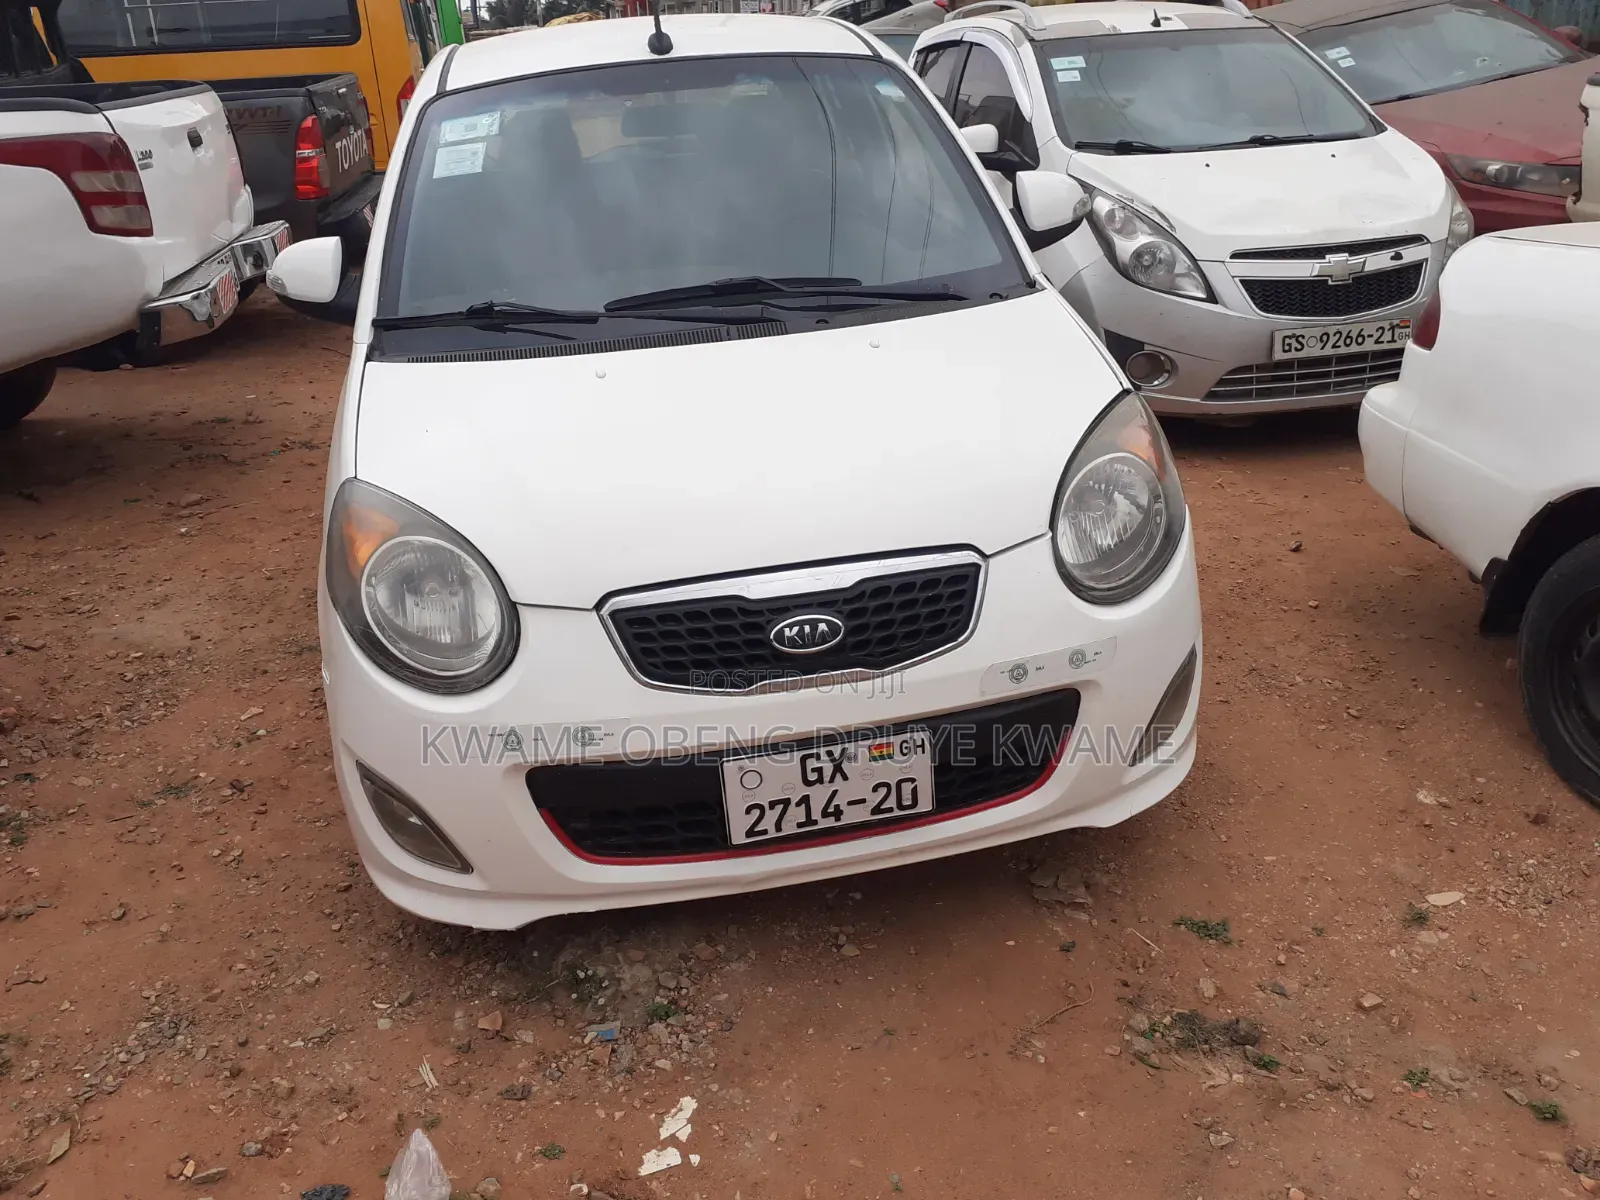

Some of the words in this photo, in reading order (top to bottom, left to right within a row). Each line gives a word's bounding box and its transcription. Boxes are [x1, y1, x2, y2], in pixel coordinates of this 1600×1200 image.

[335, 128, 368, 173] TOYOTA
[1281, 333, 1306, 354] GS
[1319, 325, 1398, 351] 9266-21
[1397, 331, 1411, 341] GH
[783, 622, 832, 647] KIA
[899, 737, 926, 757] GH
[799, 747, 850, 787] GX
[744, 777, 919, 839] 2714-20
